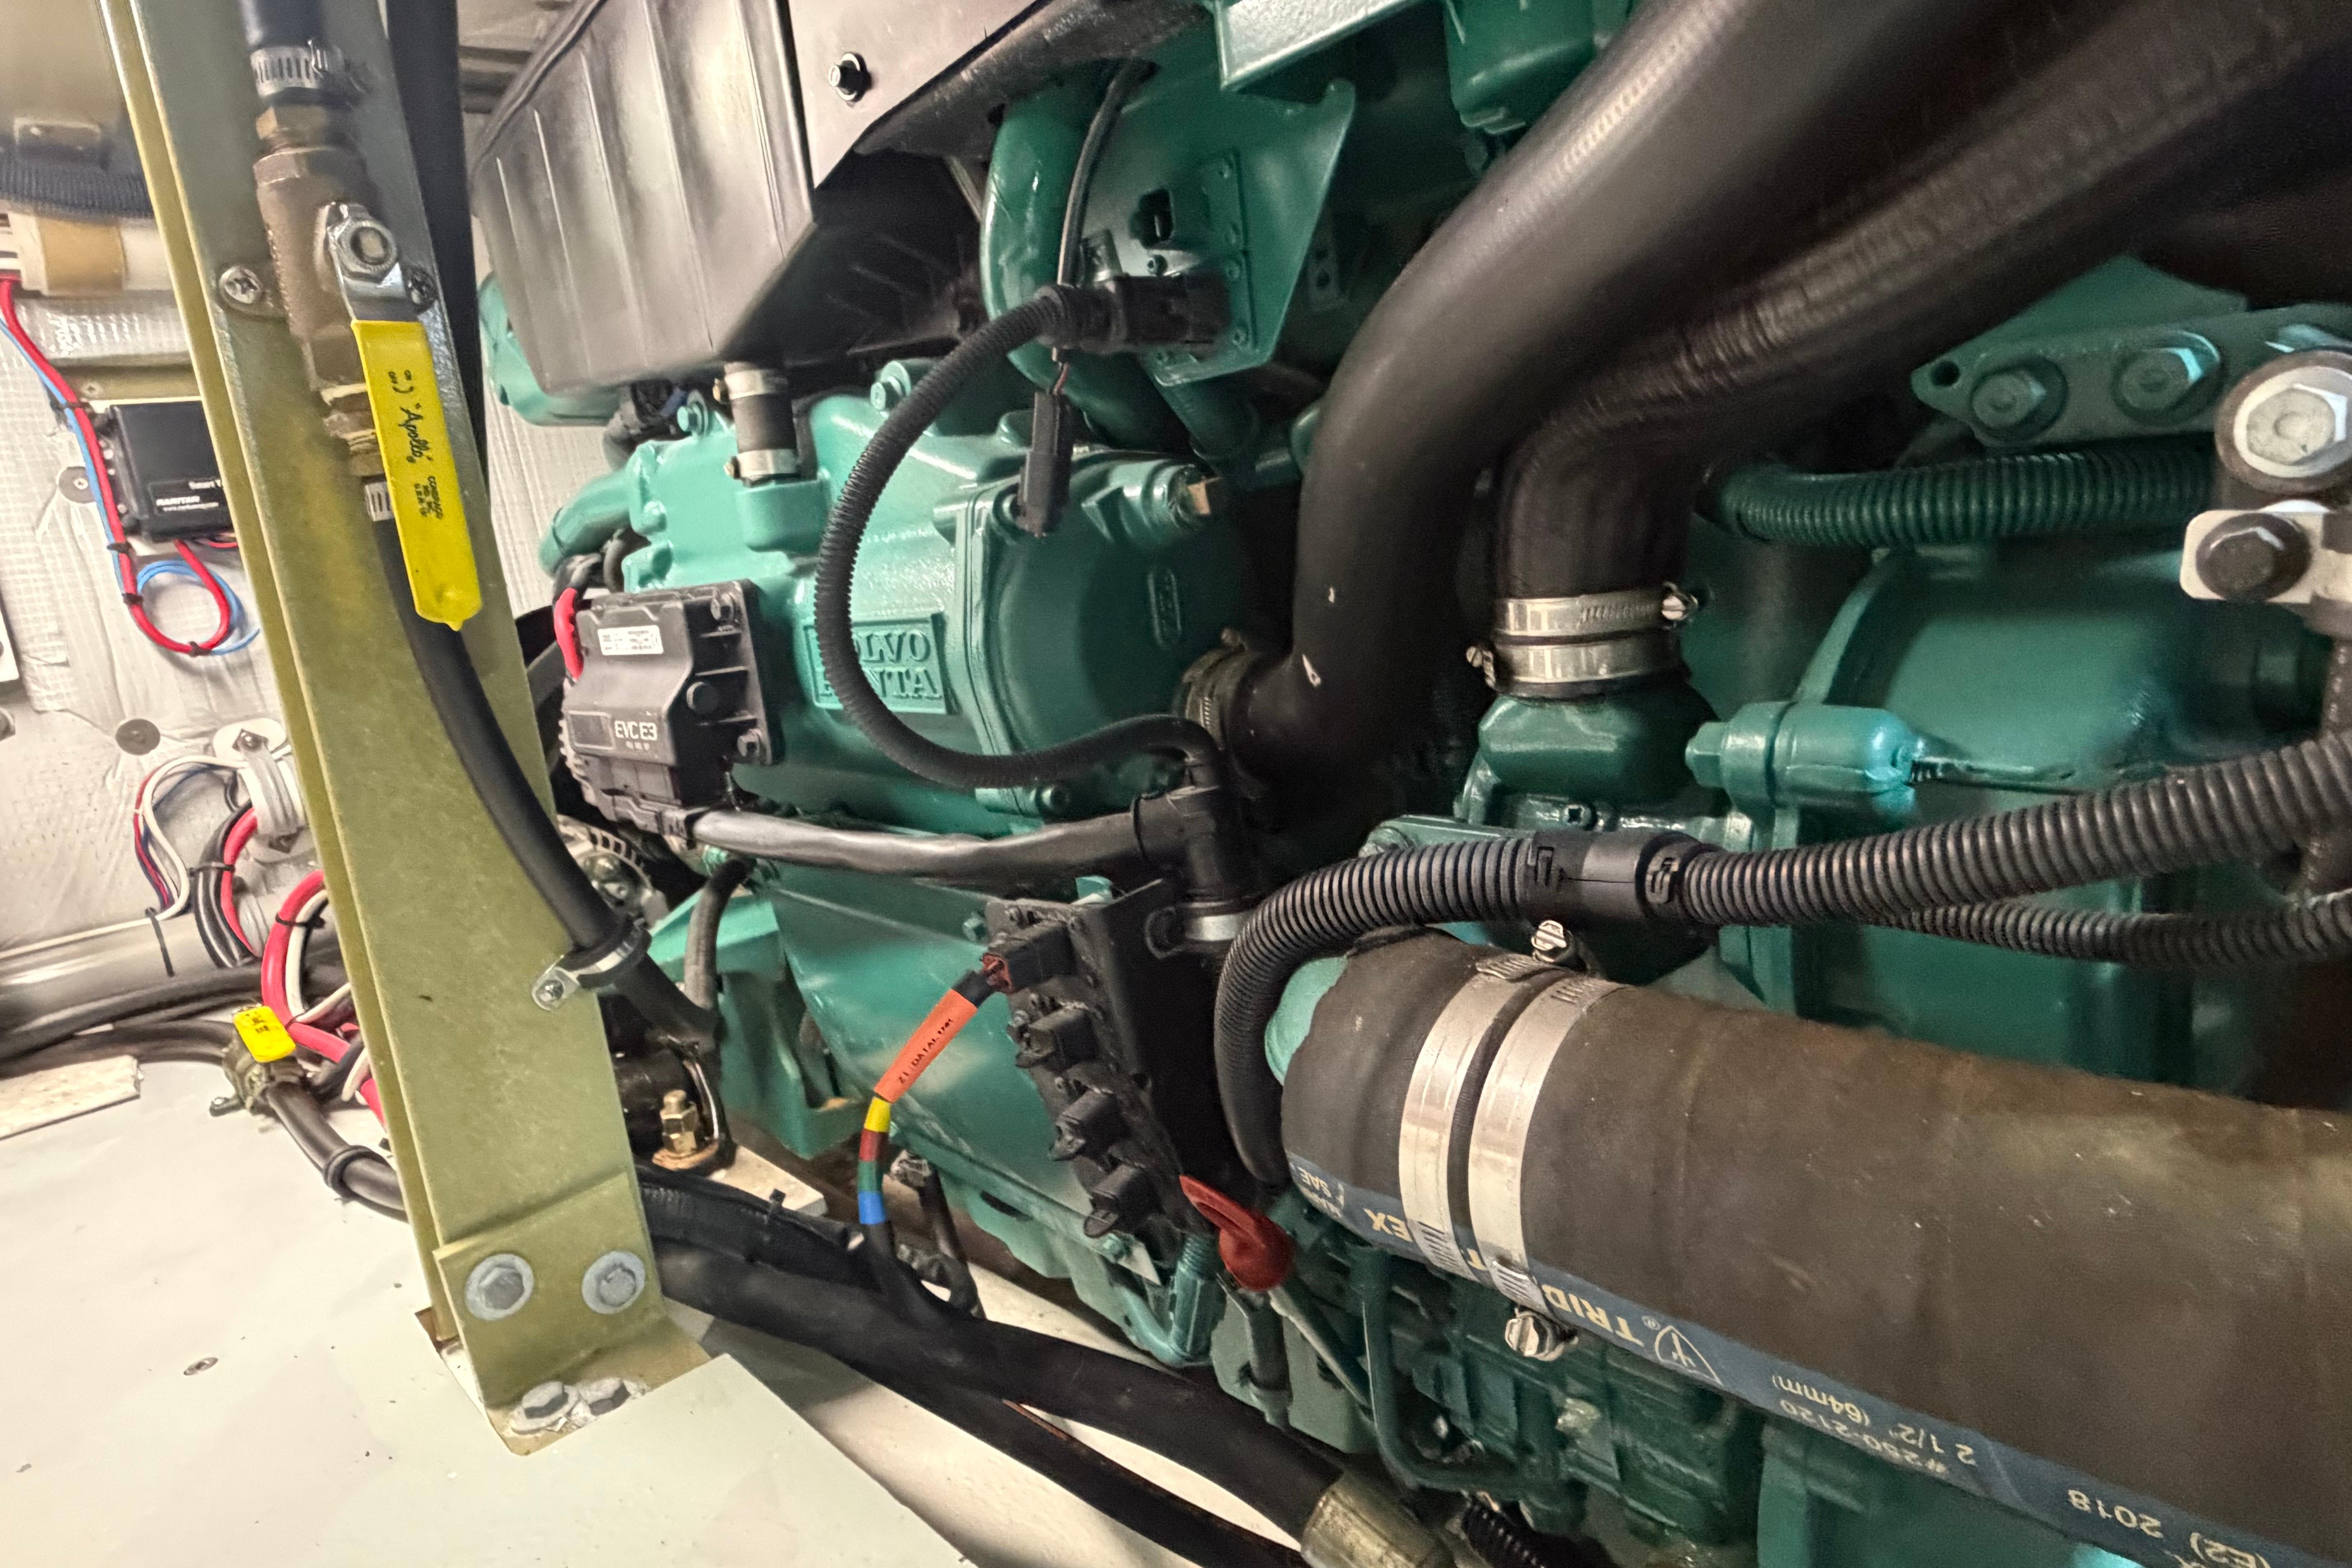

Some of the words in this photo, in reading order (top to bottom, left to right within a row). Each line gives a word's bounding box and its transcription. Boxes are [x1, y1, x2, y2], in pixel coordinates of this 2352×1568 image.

[852, 628, 931, 663] LVO
[1300, 1167, 1330, 1197] SAE
[1772, 1374, 1871, 1426] (64mm)
[1955, 1443, 1976, 1465] 2
